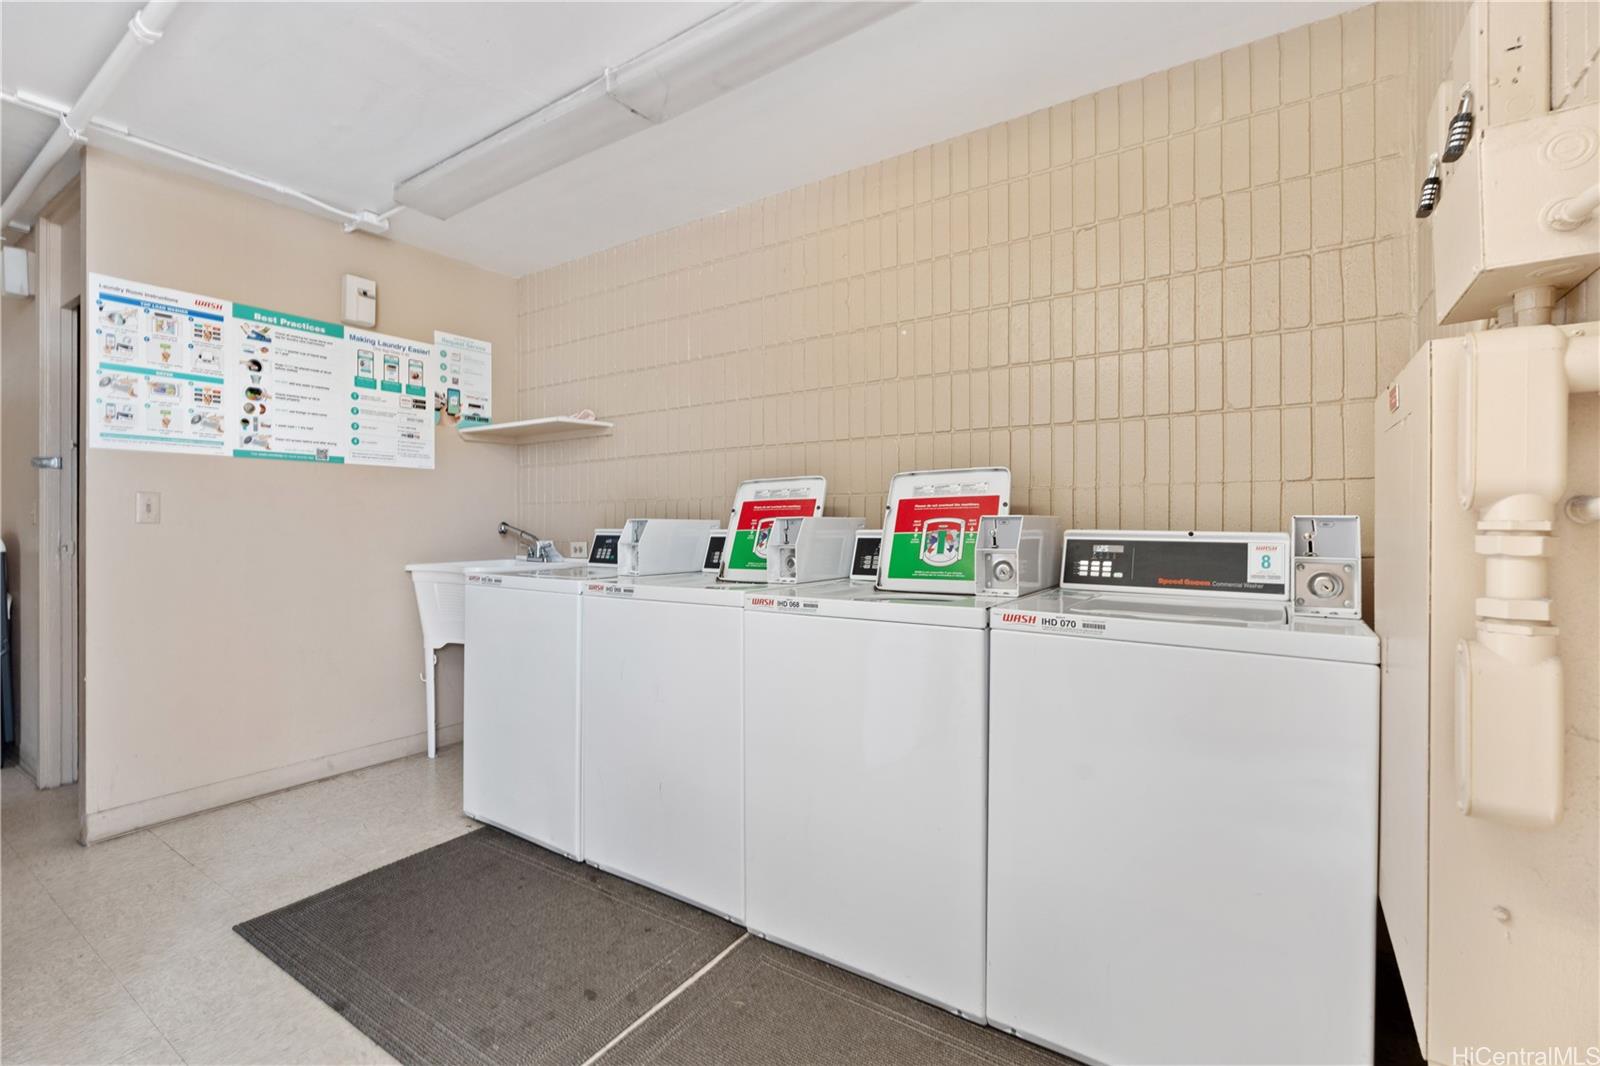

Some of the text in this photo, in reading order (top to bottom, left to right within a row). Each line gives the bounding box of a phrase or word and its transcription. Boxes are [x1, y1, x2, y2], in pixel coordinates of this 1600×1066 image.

[195, 299, 223, 311] WASH
[254, 312, 326, 334] Best Practices
[349, 333, 376, 346] Making
[378, 340, 406, 353] Laundry
[408, 346, 431, 357] Easier!
[1261, 554, 1271, 569] 8
[1157, 577, 1183, 586] Speed
[1184, 578, 1211, 587] Queen
[1211, 580, 1243, 589] Commercial
[752, 598, 775, 607] WASH
[1002, 613, 1076, 629] WASH IHD 070
